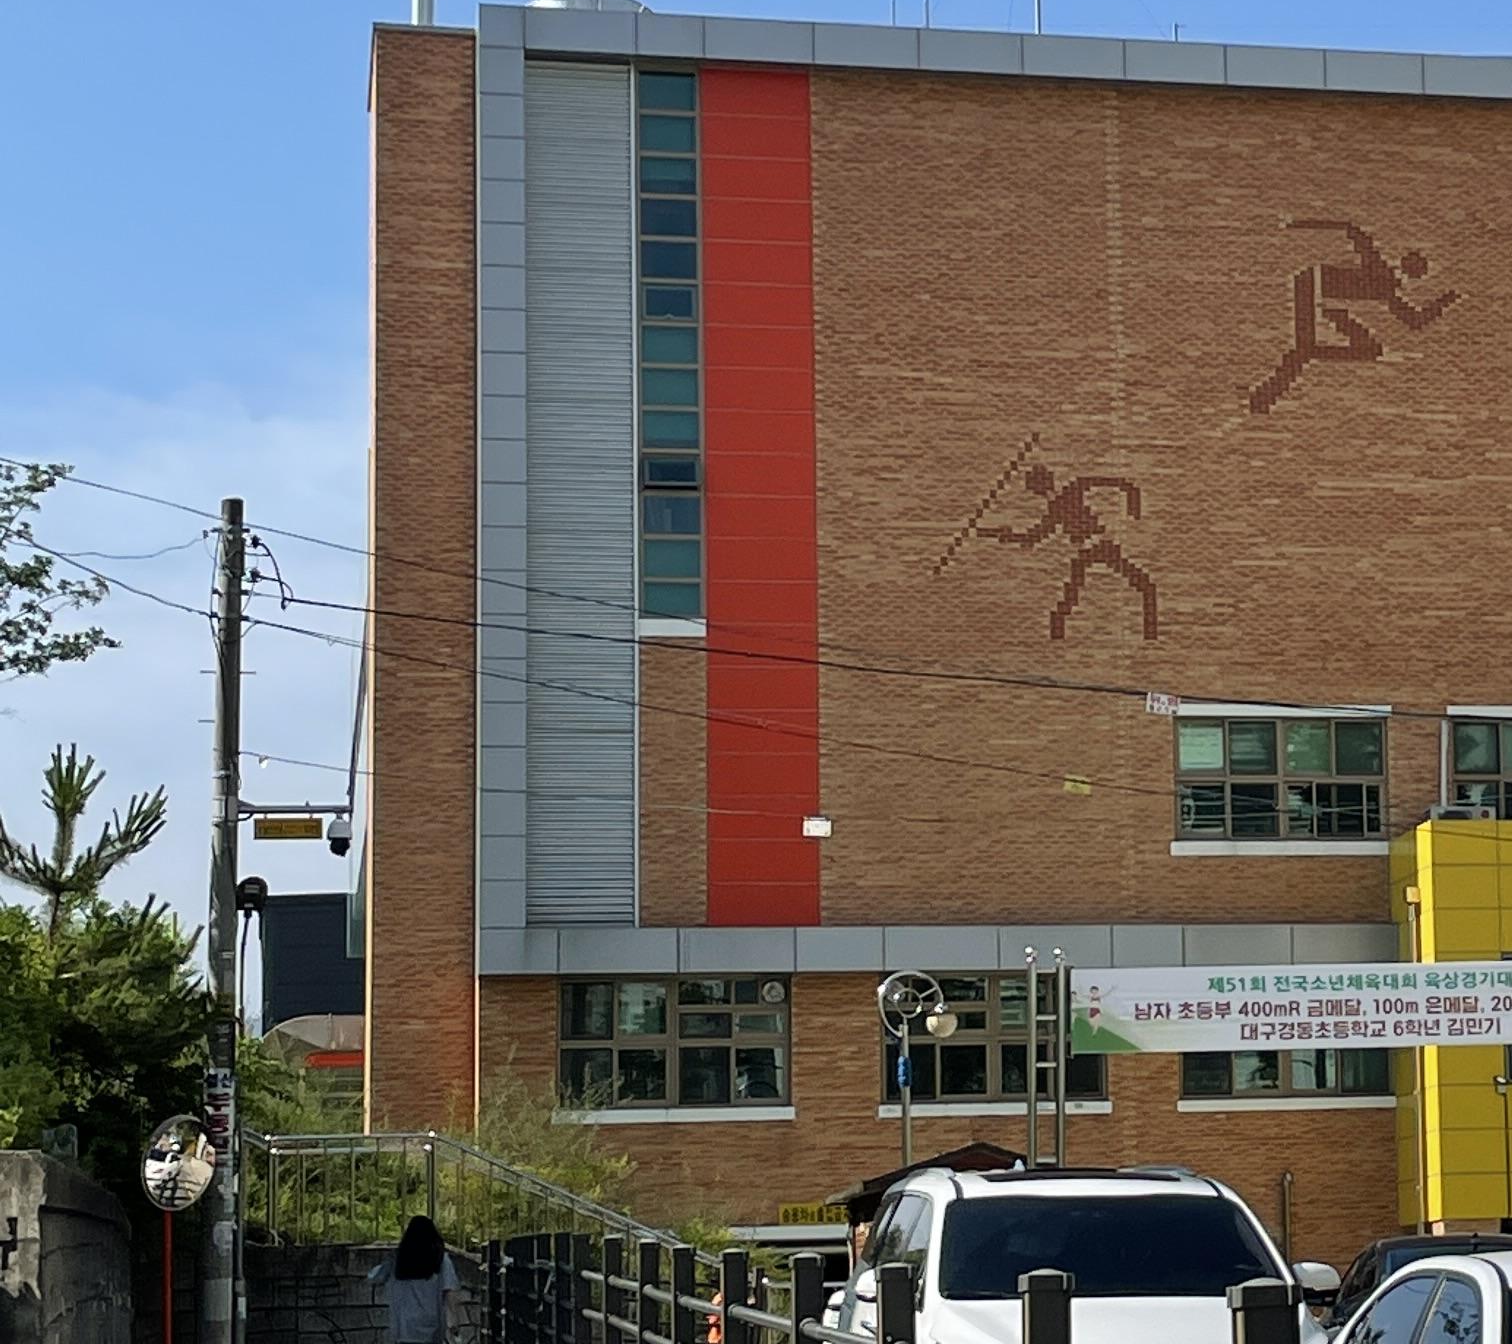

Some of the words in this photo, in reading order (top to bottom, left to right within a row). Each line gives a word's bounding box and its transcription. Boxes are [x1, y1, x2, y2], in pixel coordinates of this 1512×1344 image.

[1207, 975, 1266, 993] 제51회
[1273, 972, 1418, 993] 전국소년체육대회
[1134, 1002, 1171, 1020] 남자
[1178, 1001, 1232, 1020] 초등부
[1238, 1000, 1301, 1017] 400mR
[1372, 997, 1419, 1015] 100m
[1240, 1019, 1387, 1041] 대구경동초등학교
[1393, 1018, 1440, 1037] 6학년
[1447, 1017, 1501, 1036] 김민기
